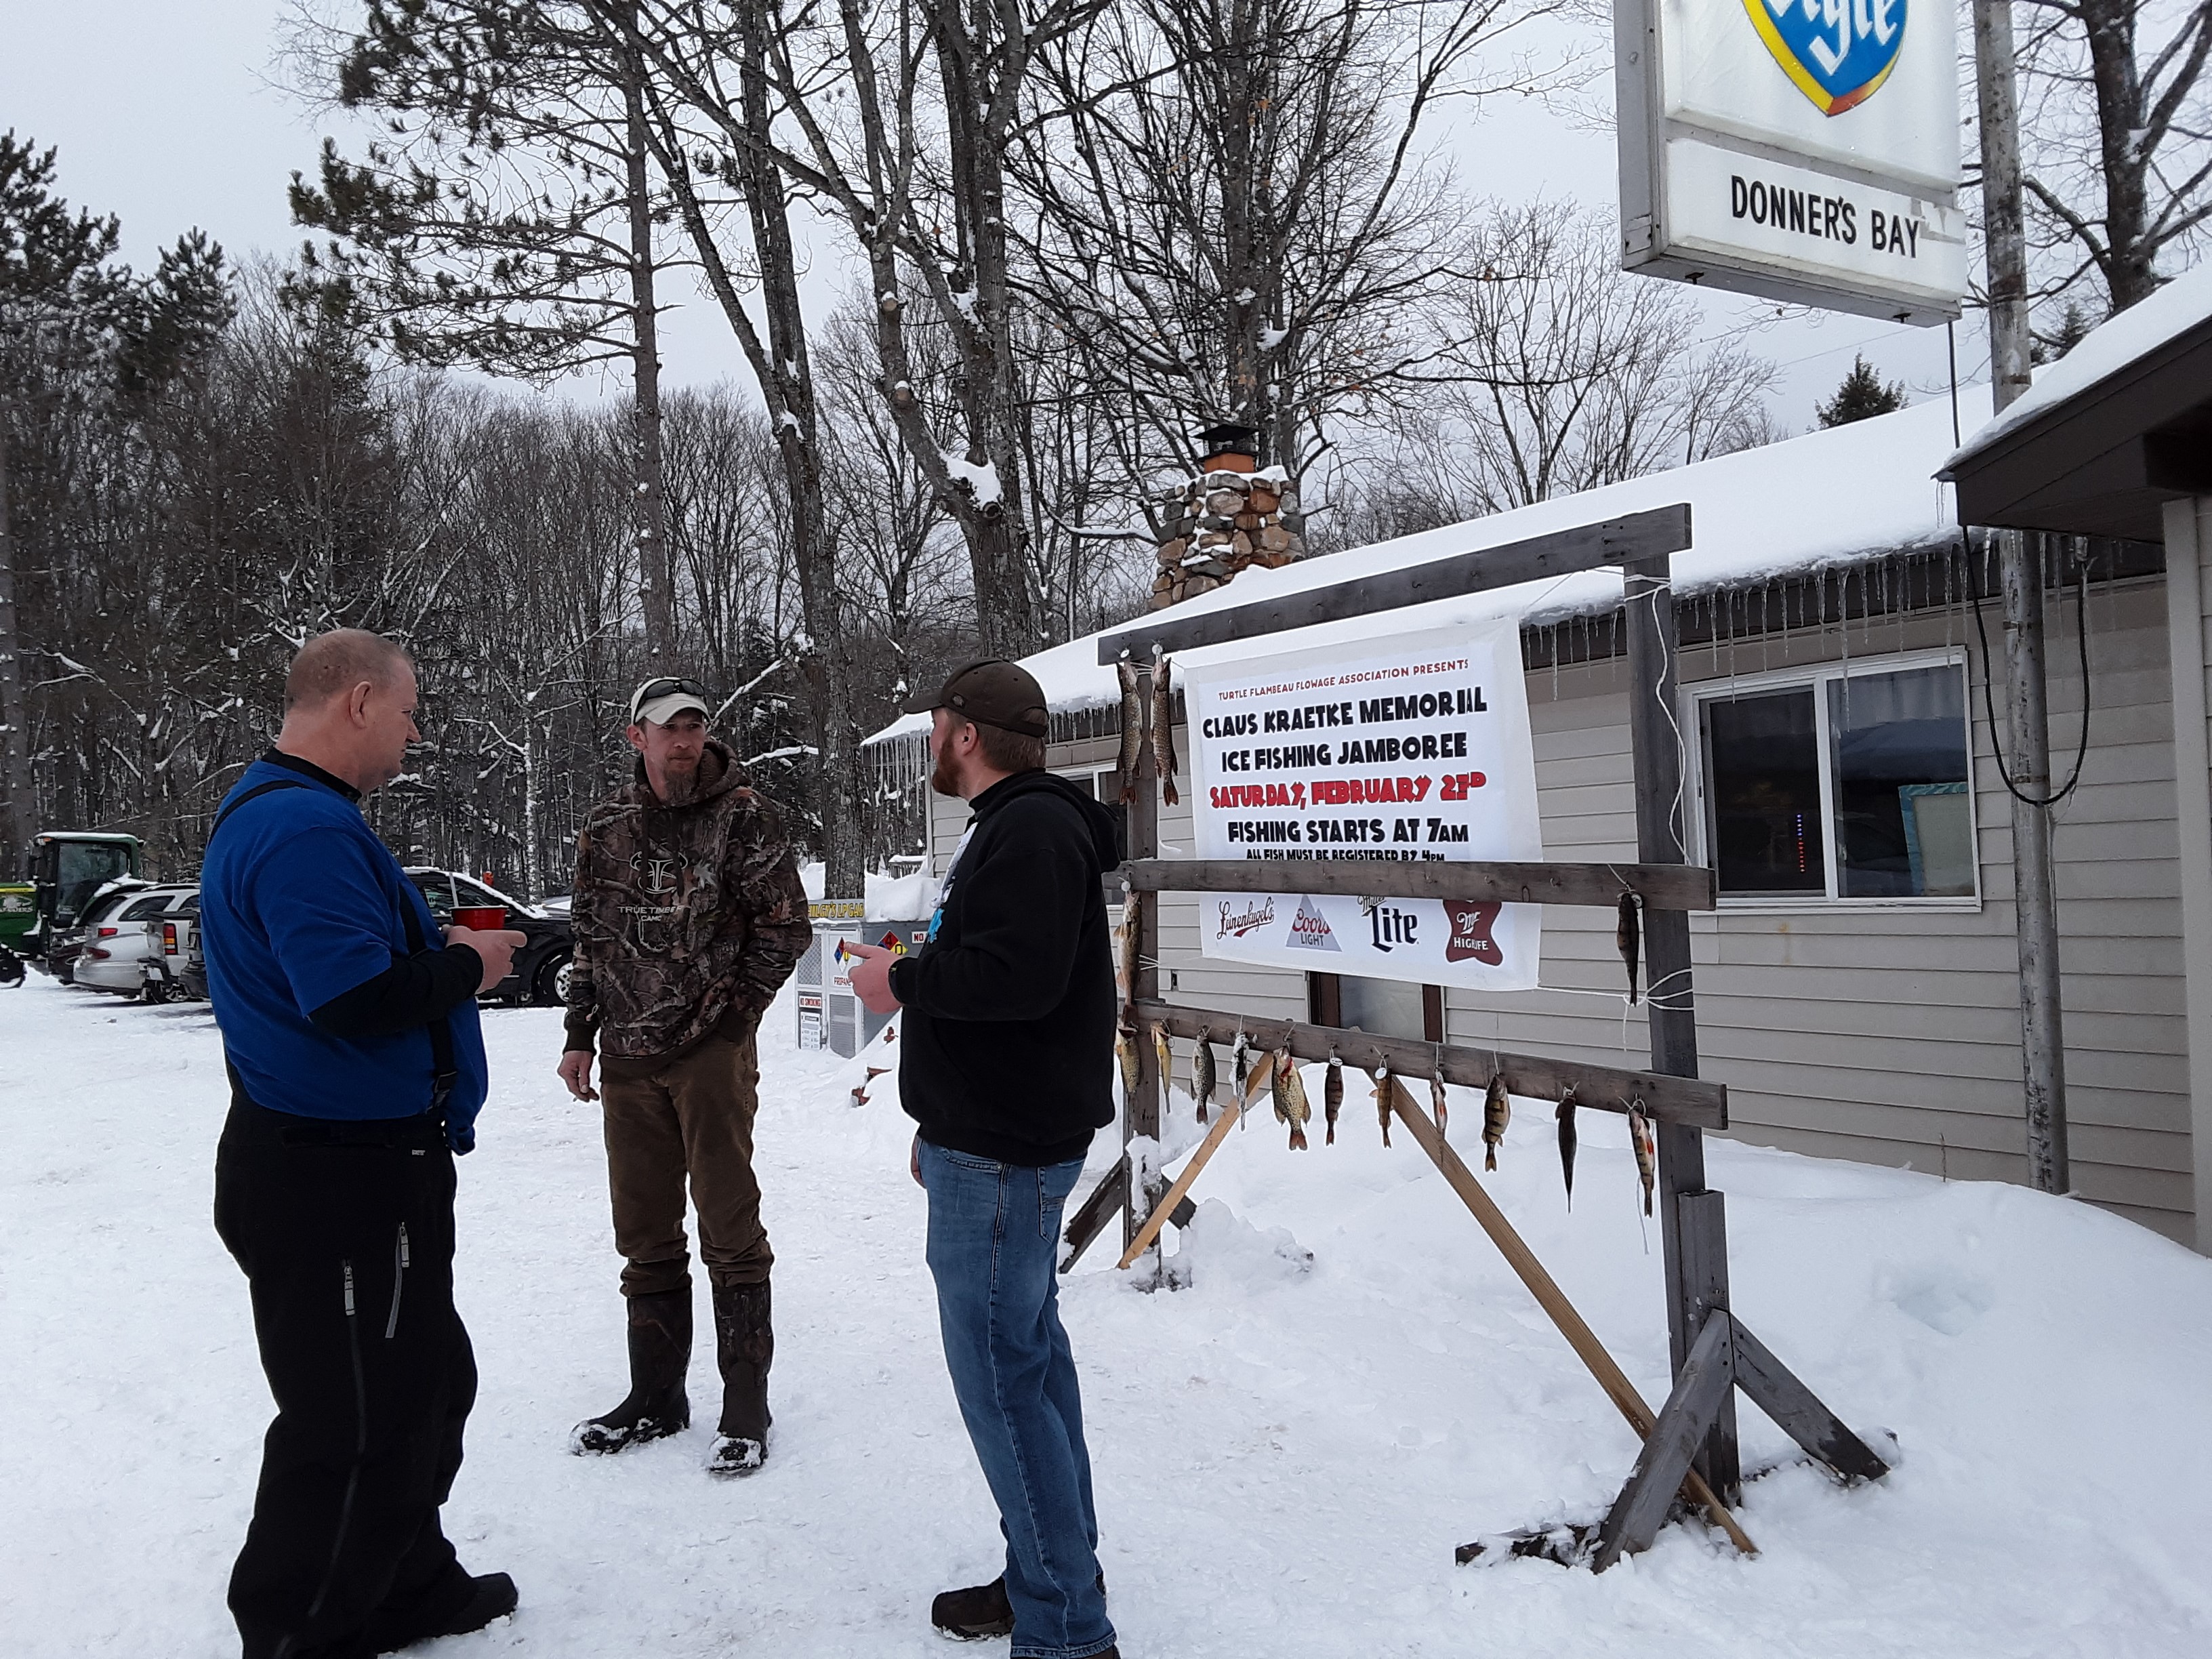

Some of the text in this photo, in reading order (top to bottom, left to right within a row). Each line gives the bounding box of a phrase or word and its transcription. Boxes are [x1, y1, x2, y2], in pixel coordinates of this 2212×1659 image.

[1731, 174, 1919, 259] DONNER'S BAY
[1218, 659, 1469, 701] TURTLE FLAMBEAU FLOWAGE ASSOCIATION PRESENTS
[1203, 686, 1488, 739] CLAUS KRAETKE MEMORIAL
[1222, 732, 1467, 773] ICE FISHING JAMBOREE
[1210, 781, 1307, 810] SATURDAY,
[1311, 774, 1433, 805] FEBRUARY
[1228, 817, 1469, 843] FISHING STARTS AT 7AM
[1246, 848, 1445, 861] ALL FISH MUST BE REGISTERED BY 4PM
[837, 903, 848, 918] LP
[848, 903, 864, 918] GAS
[1216, 896, 1275, 940] Leinenkugel's
[1292, 908, 1332, 935] Coors
[914, 933, 924, 942] NO
[1300, 933, 1324, 947] LIGHT
[1371, 905, 1418, 953] Lite
